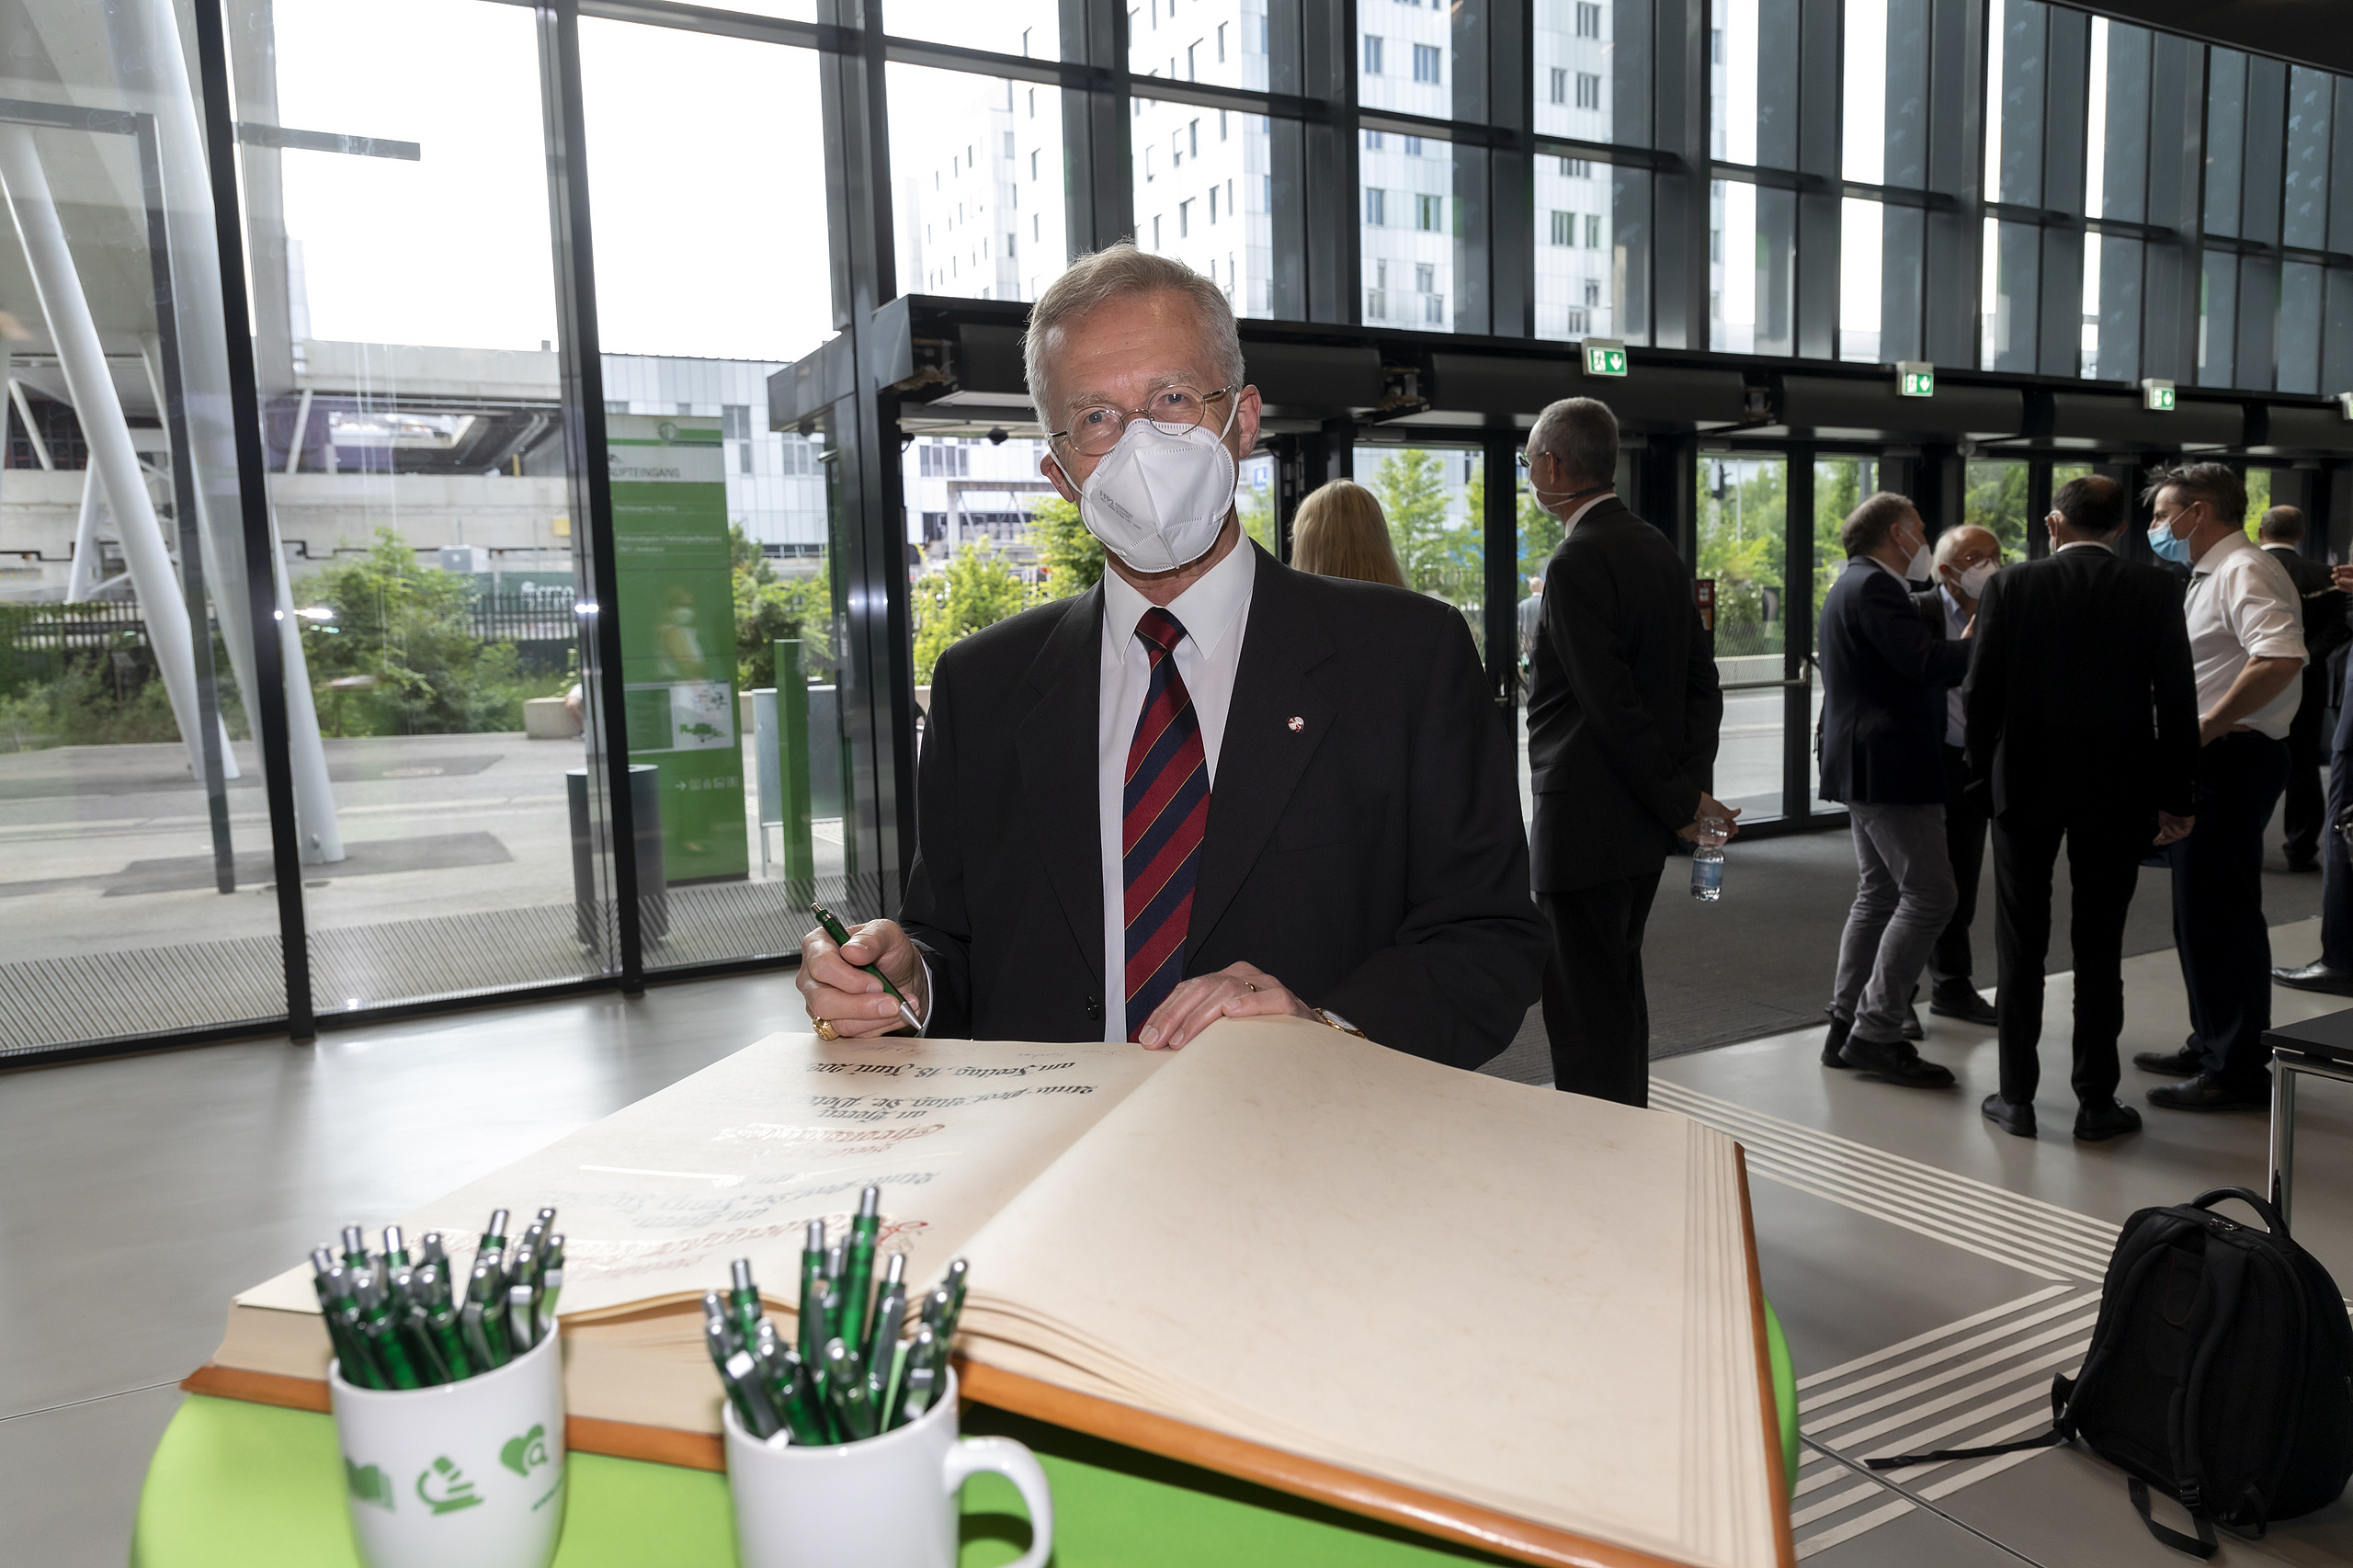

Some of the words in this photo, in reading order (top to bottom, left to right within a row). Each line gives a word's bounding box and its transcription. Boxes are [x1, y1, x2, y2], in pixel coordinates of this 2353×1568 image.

[608, 467, 681, 478] AUPTEINGANG
[801, 1062, 855, 1074] 202
[847, 1062, 915, 1076] Juni
